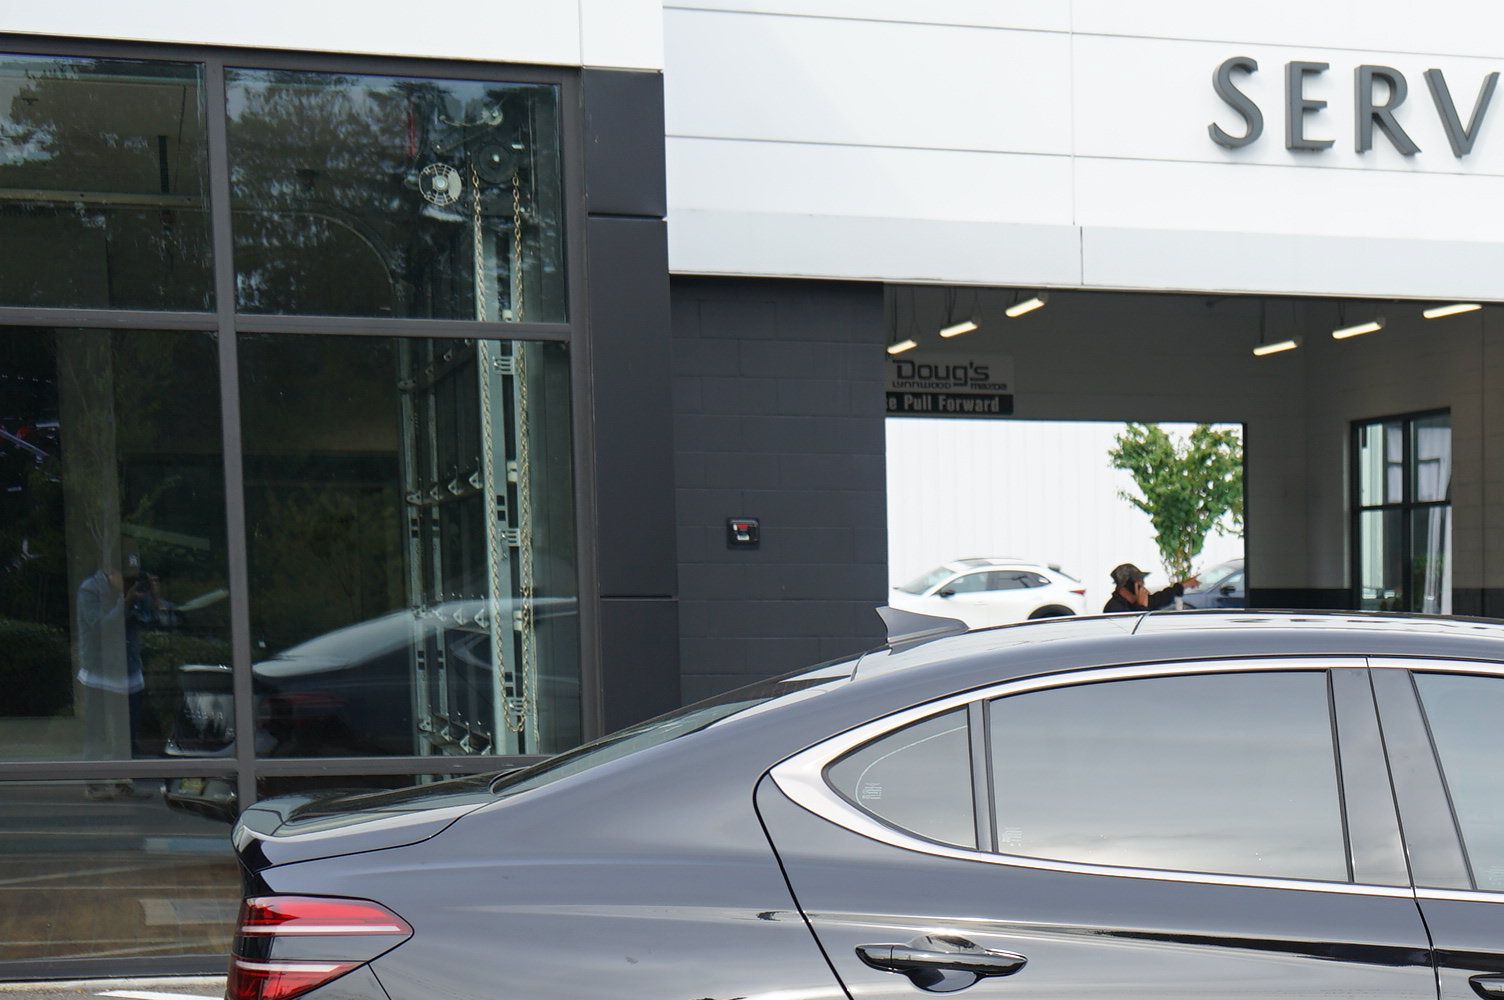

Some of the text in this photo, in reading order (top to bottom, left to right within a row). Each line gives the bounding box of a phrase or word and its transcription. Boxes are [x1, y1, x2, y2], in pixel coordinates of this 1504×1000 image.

[892, 360, 990, 387] Doug's
[904, 394, 932, 411] Pull
[938, 395, 999, 412] Forward
